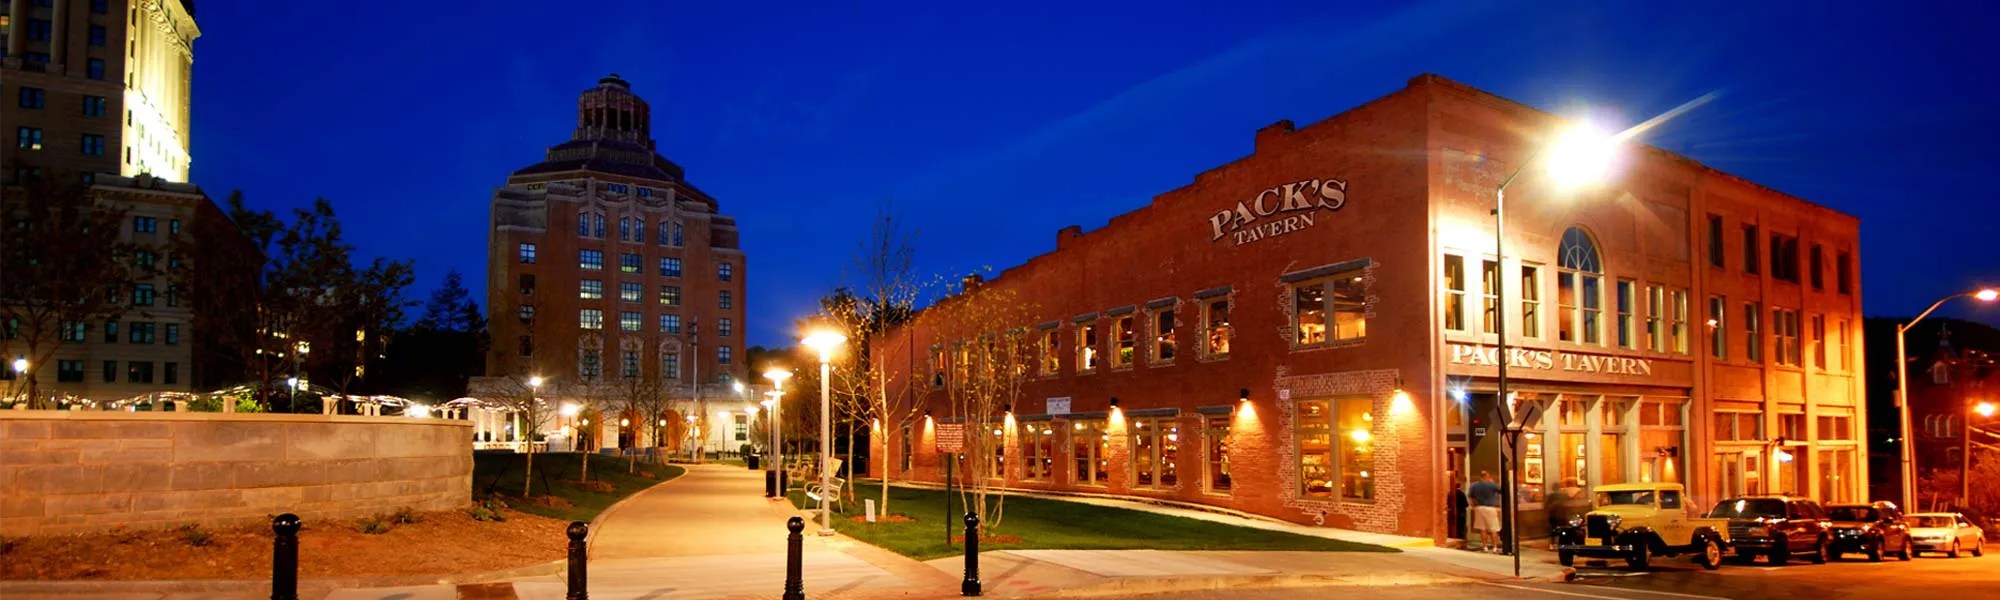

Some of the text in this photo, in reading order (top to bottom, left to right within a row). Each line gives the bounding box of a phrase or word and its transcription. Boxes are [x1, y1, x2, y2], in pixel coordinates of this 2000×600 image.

[1209, 179, 1348, 241] PACK'S
[1233, 211, 1316, 246] TAVERN
[1451, 343, 1653, 376] PACK'S TAVERN
